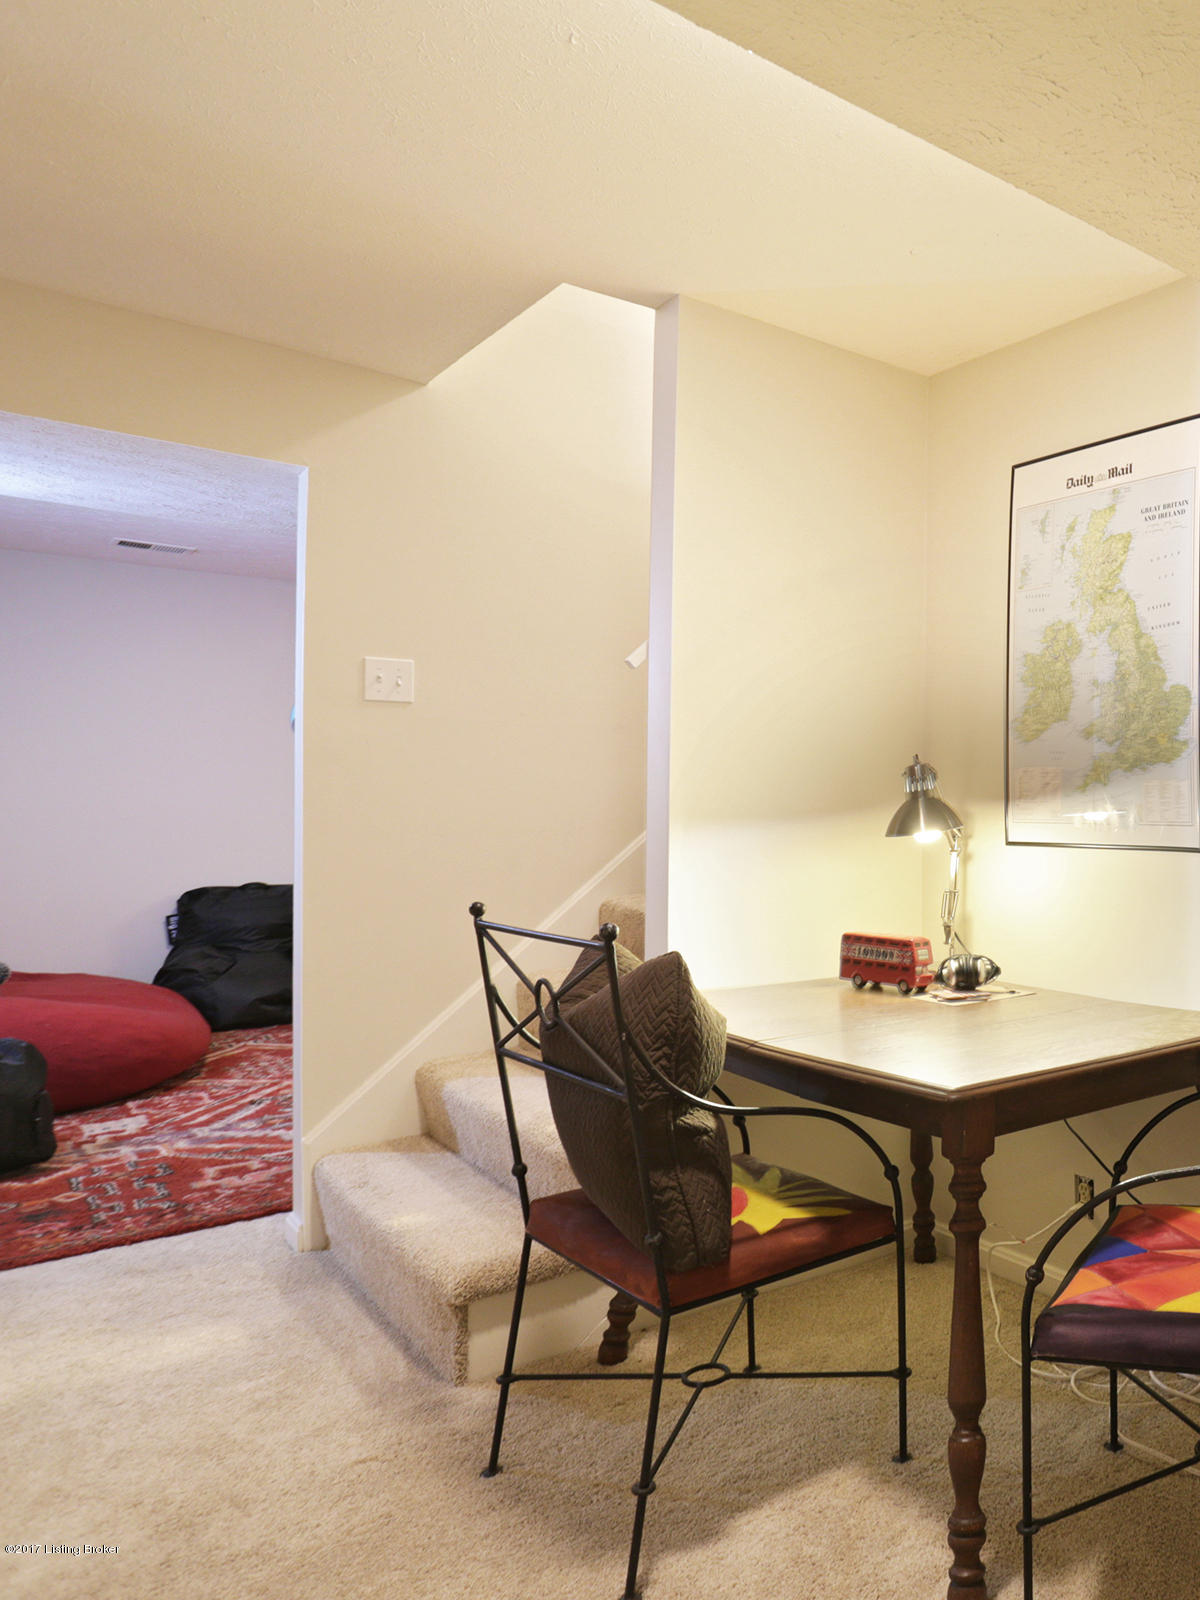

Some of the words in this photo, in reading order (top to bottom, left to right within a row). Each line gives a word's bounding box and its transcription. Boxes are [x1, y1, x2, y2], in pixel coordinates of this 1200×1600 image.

[1066, 475, 1094, 491] Daily
[1108, 463, 1134, 480] Mail
[1140, 504, 1161, 515] GREAT
[1163, 499, 1189, 511] BRITAIN
[1144, 514, 1157, 523] AND
[1158, 509, 1186, 520] IRELAND
